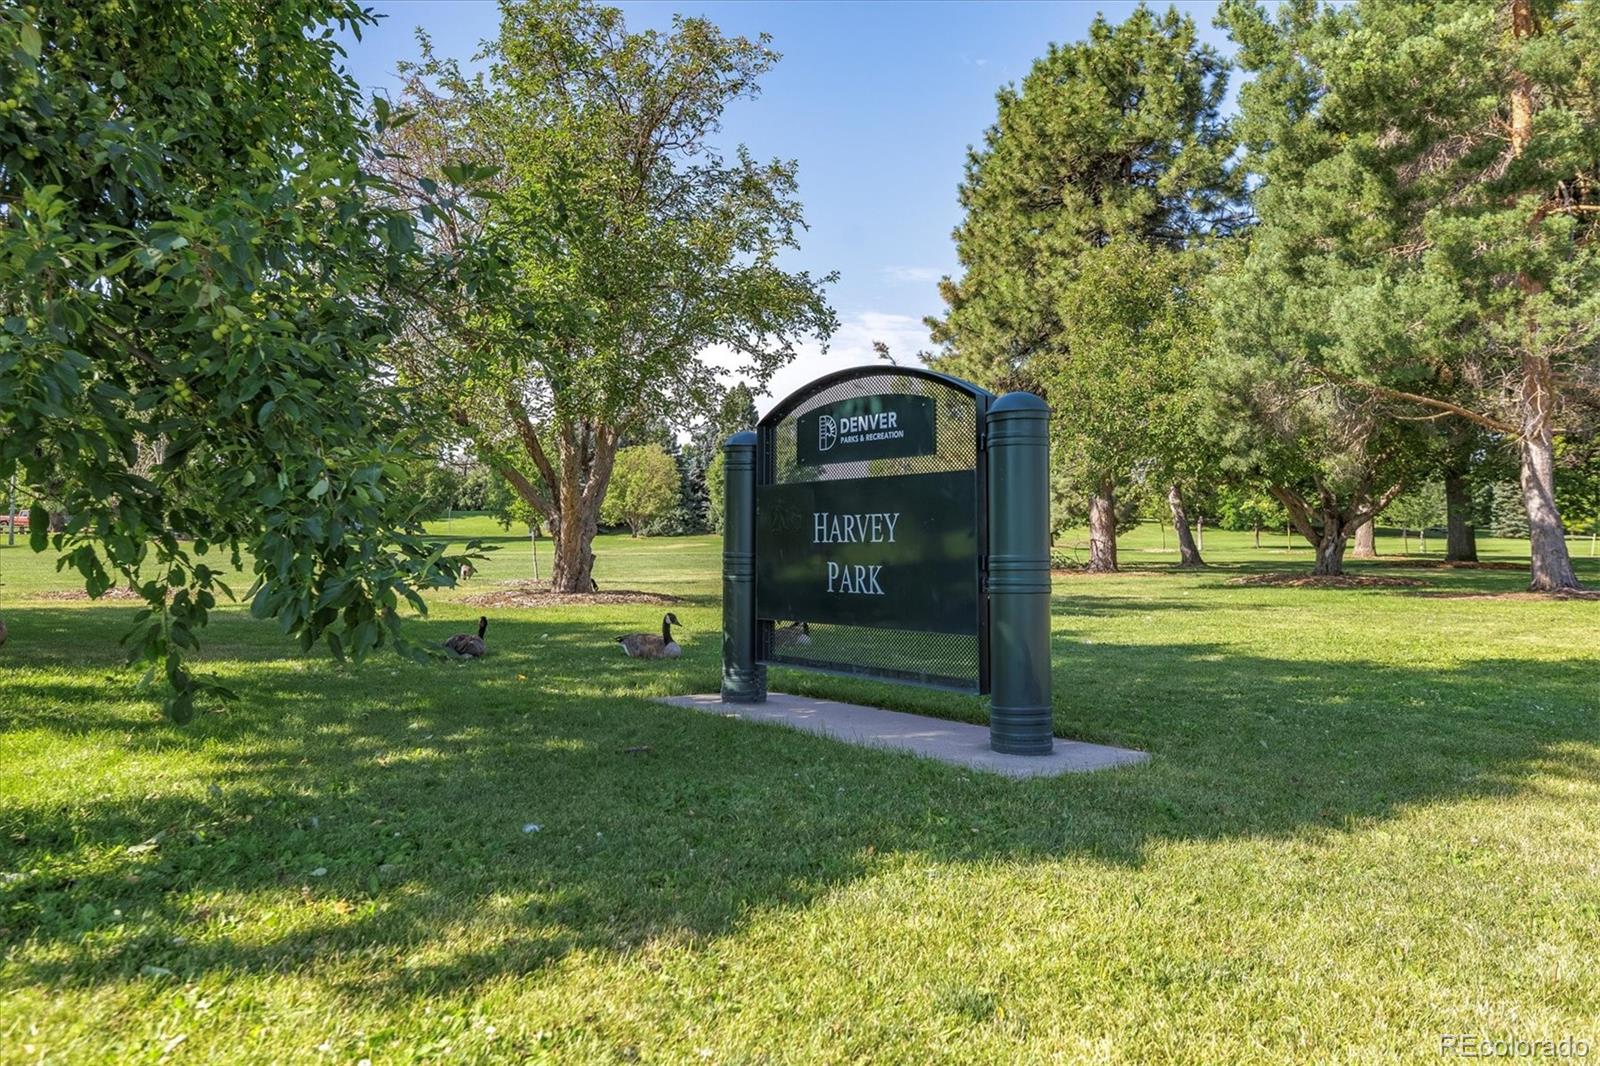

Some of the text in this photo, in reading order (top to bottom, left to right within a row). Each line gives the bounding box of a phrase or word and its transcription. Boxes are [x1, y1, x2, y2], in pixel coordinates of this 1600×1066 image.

[840, 411, 897, 434] DENVER
[840, 430, 904, 444] PARKS & RECREATION
[813, 512, 900, 543] HARVEY
[826, 561, 885, 595] PARK
